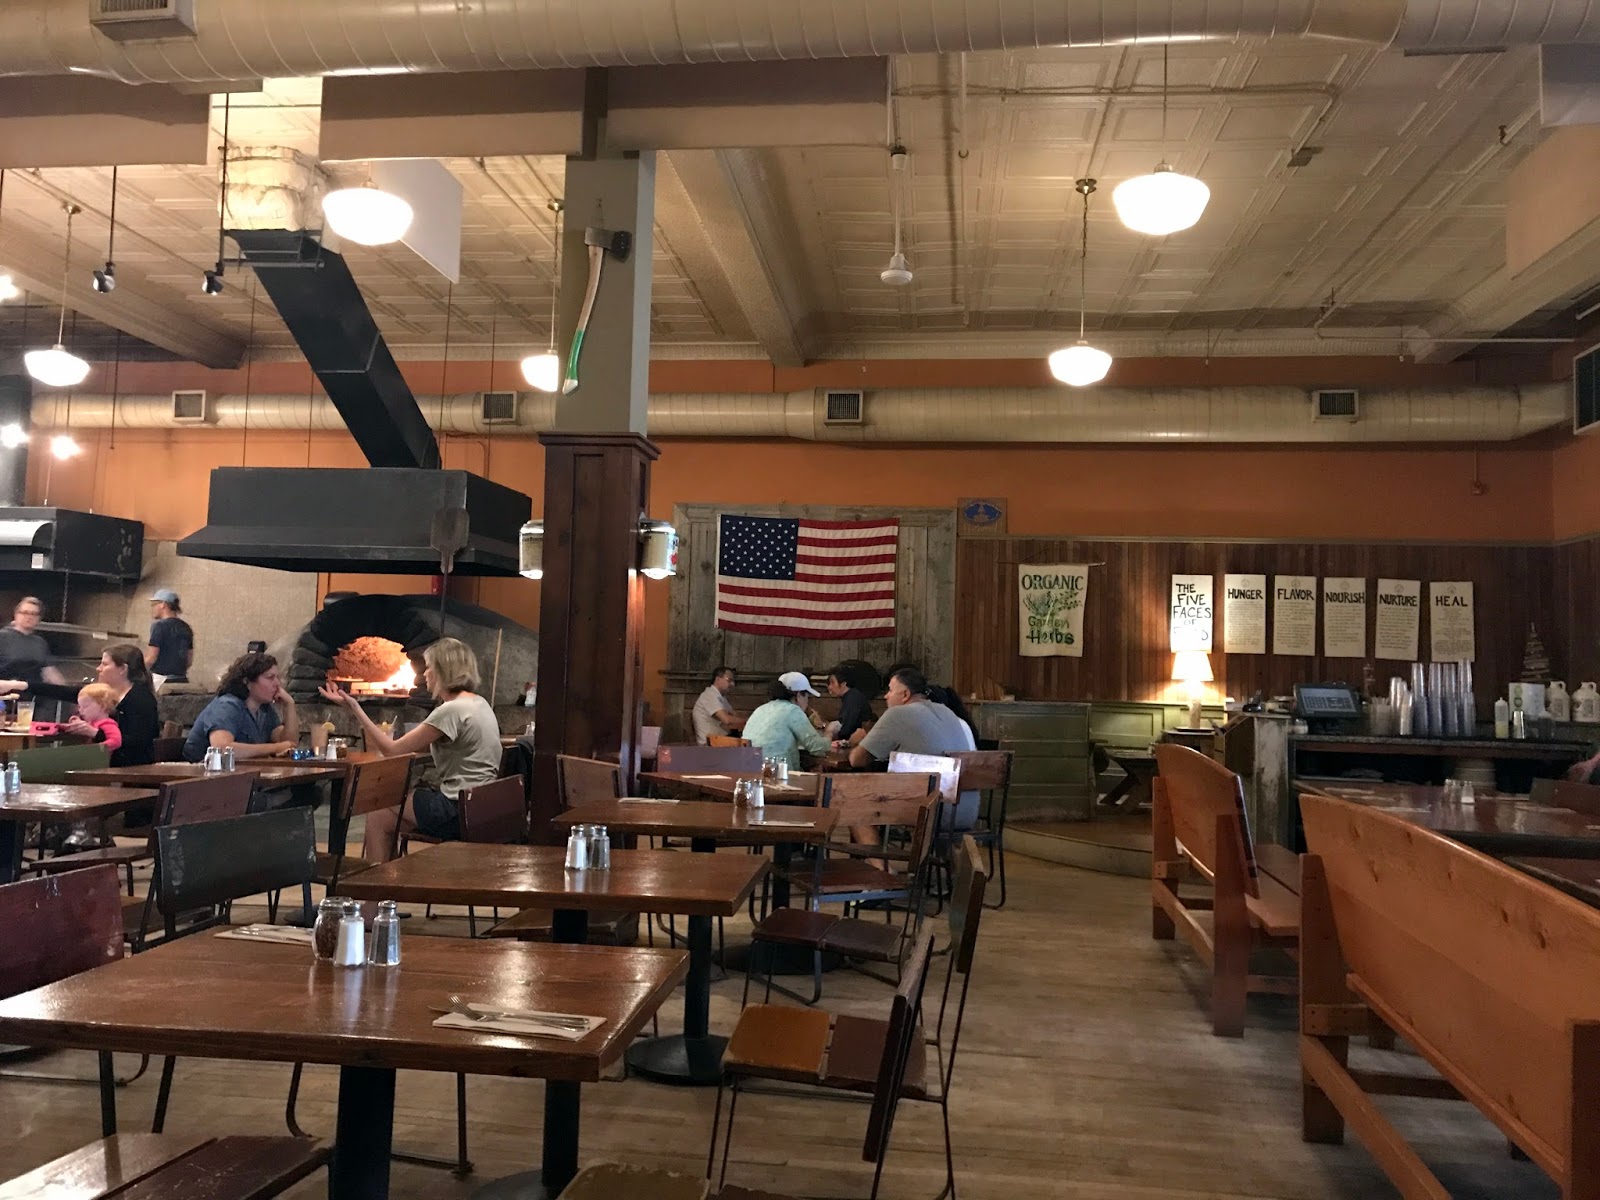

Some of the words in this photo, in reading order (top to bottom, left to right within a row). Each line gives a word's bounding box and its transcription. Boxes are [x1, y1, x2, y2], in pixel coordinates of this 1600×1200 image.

[1021, 574, 1084, 591] ORGANIC
[1175, 583, 1197, 594] THE
[1177, 593, 1207, 607] FIVE
[1227, 588, 1264, 600] HUNGER
[1277, 588, 1315, 601] FLAVOR
[1325, 591, 1366, 604] NOURISH
[1379, 593, 1418, 607] NURTURE
[1435, 595, 1469, 607] HEAL
[1173, 605, 1212, 619] FACES
[1026, 628, 1075, 646] Herbs
